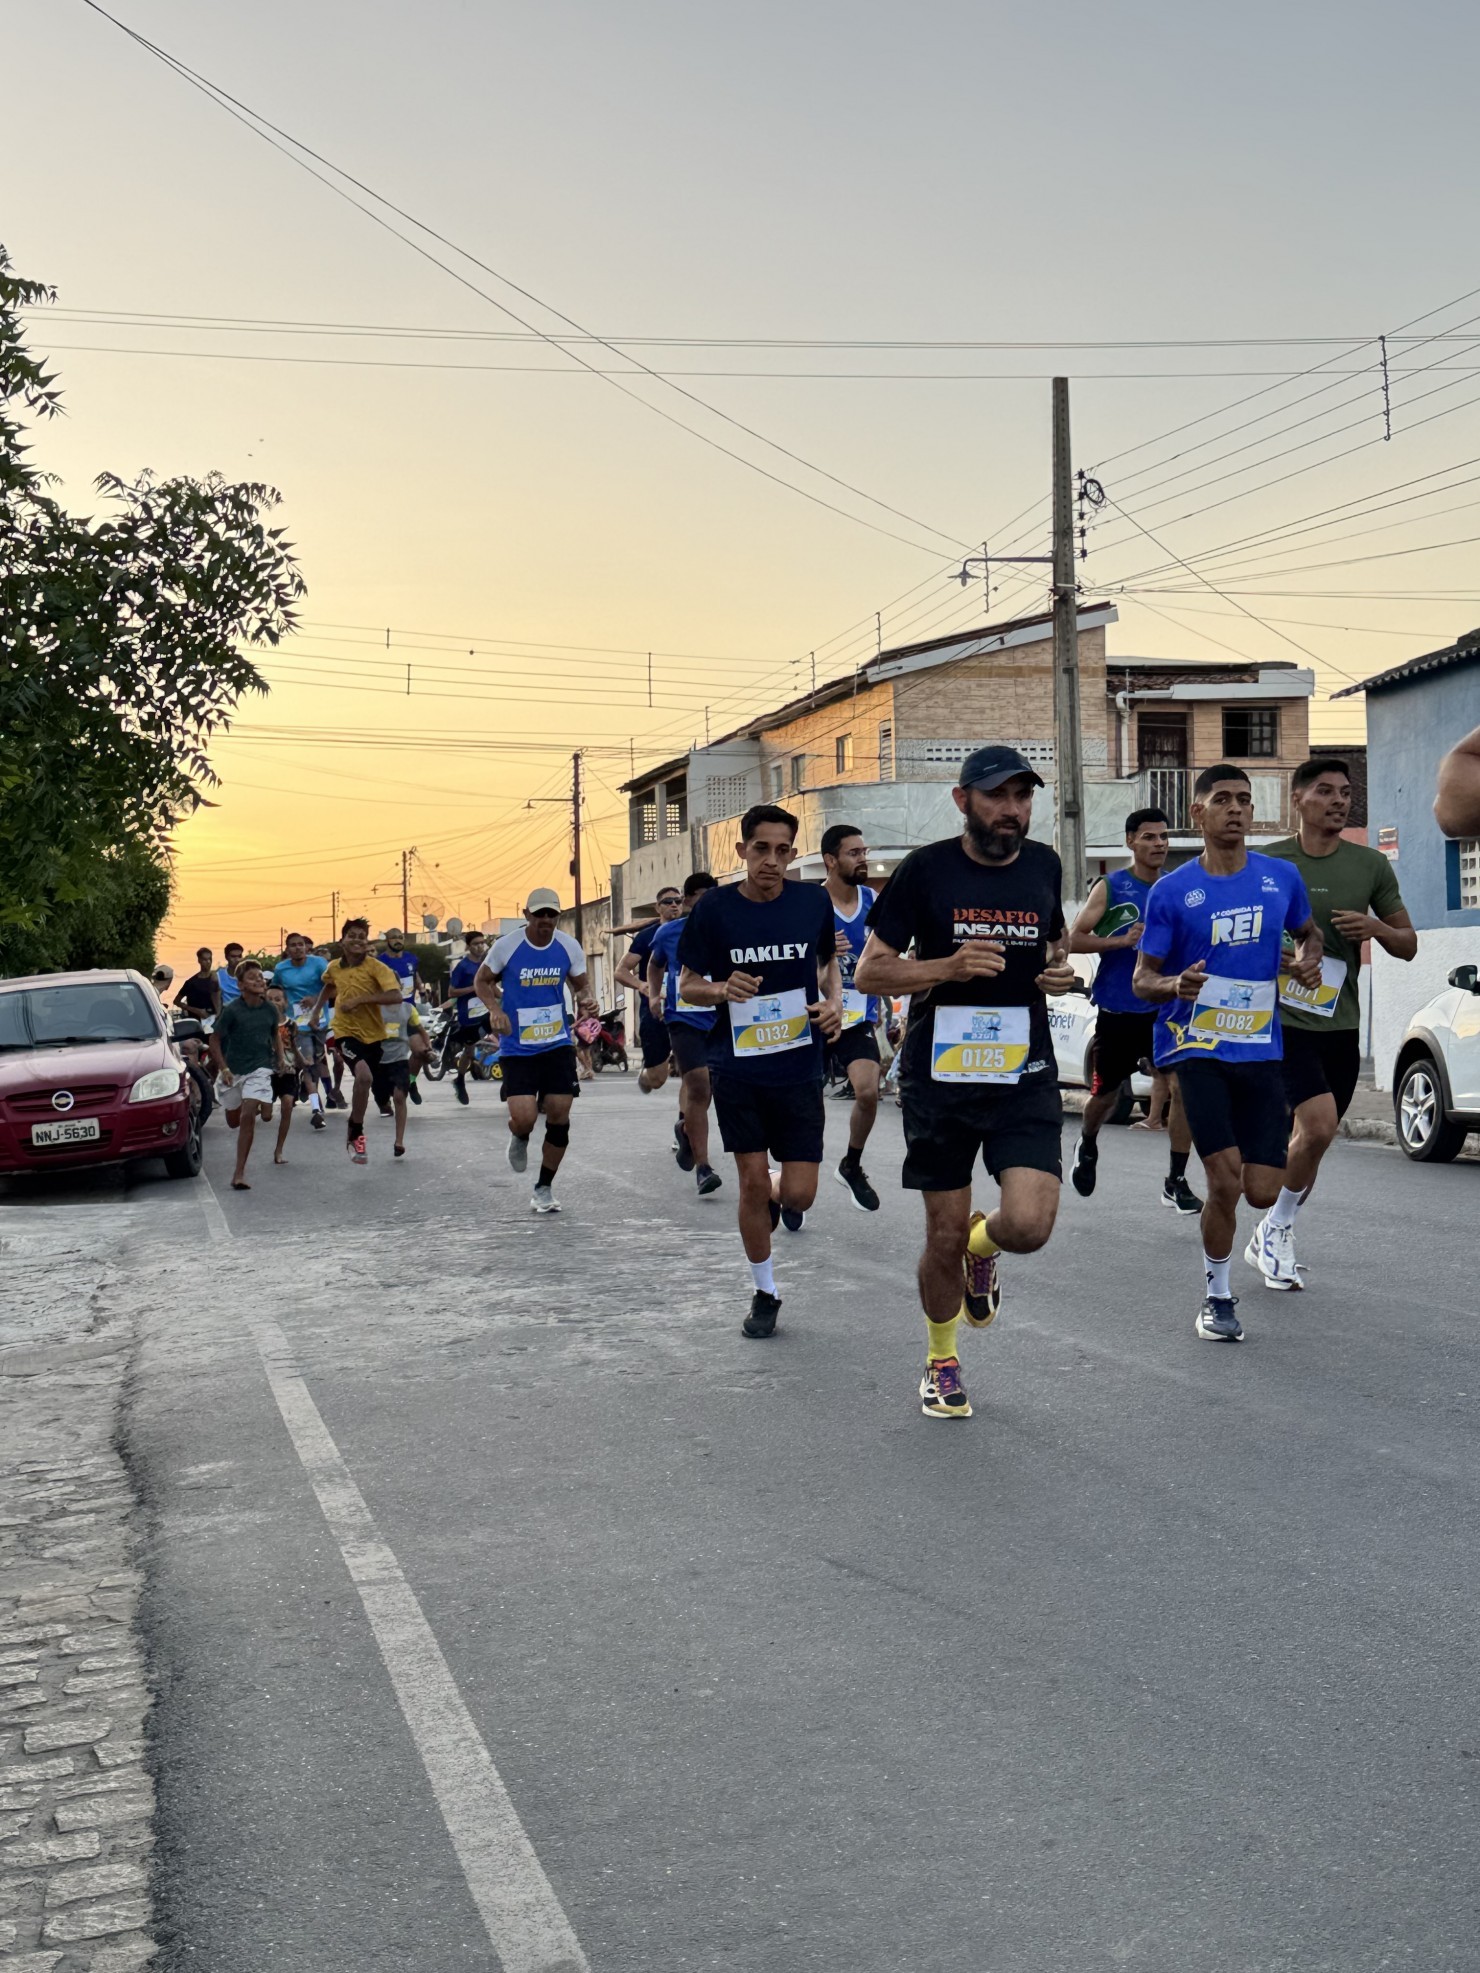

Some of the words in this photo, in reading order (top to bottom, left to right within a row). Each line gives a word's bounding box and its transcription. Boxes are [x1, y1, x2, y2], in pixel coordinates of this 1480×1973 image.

[953, 908, 1039, 924] DESAFIO
[953, 923, 1039, 939] INSANO
[1211, 911, 1262, 946] REI
[729, 942, 809, 965] OAKLEY
[1215, 1012, 1255, 1031] 0082
[755, 1023, 790, 1043] 0132
[961, 1047, 1006, 1068] 0125
[36, 1126, 95, 1142] NNJ-5630
